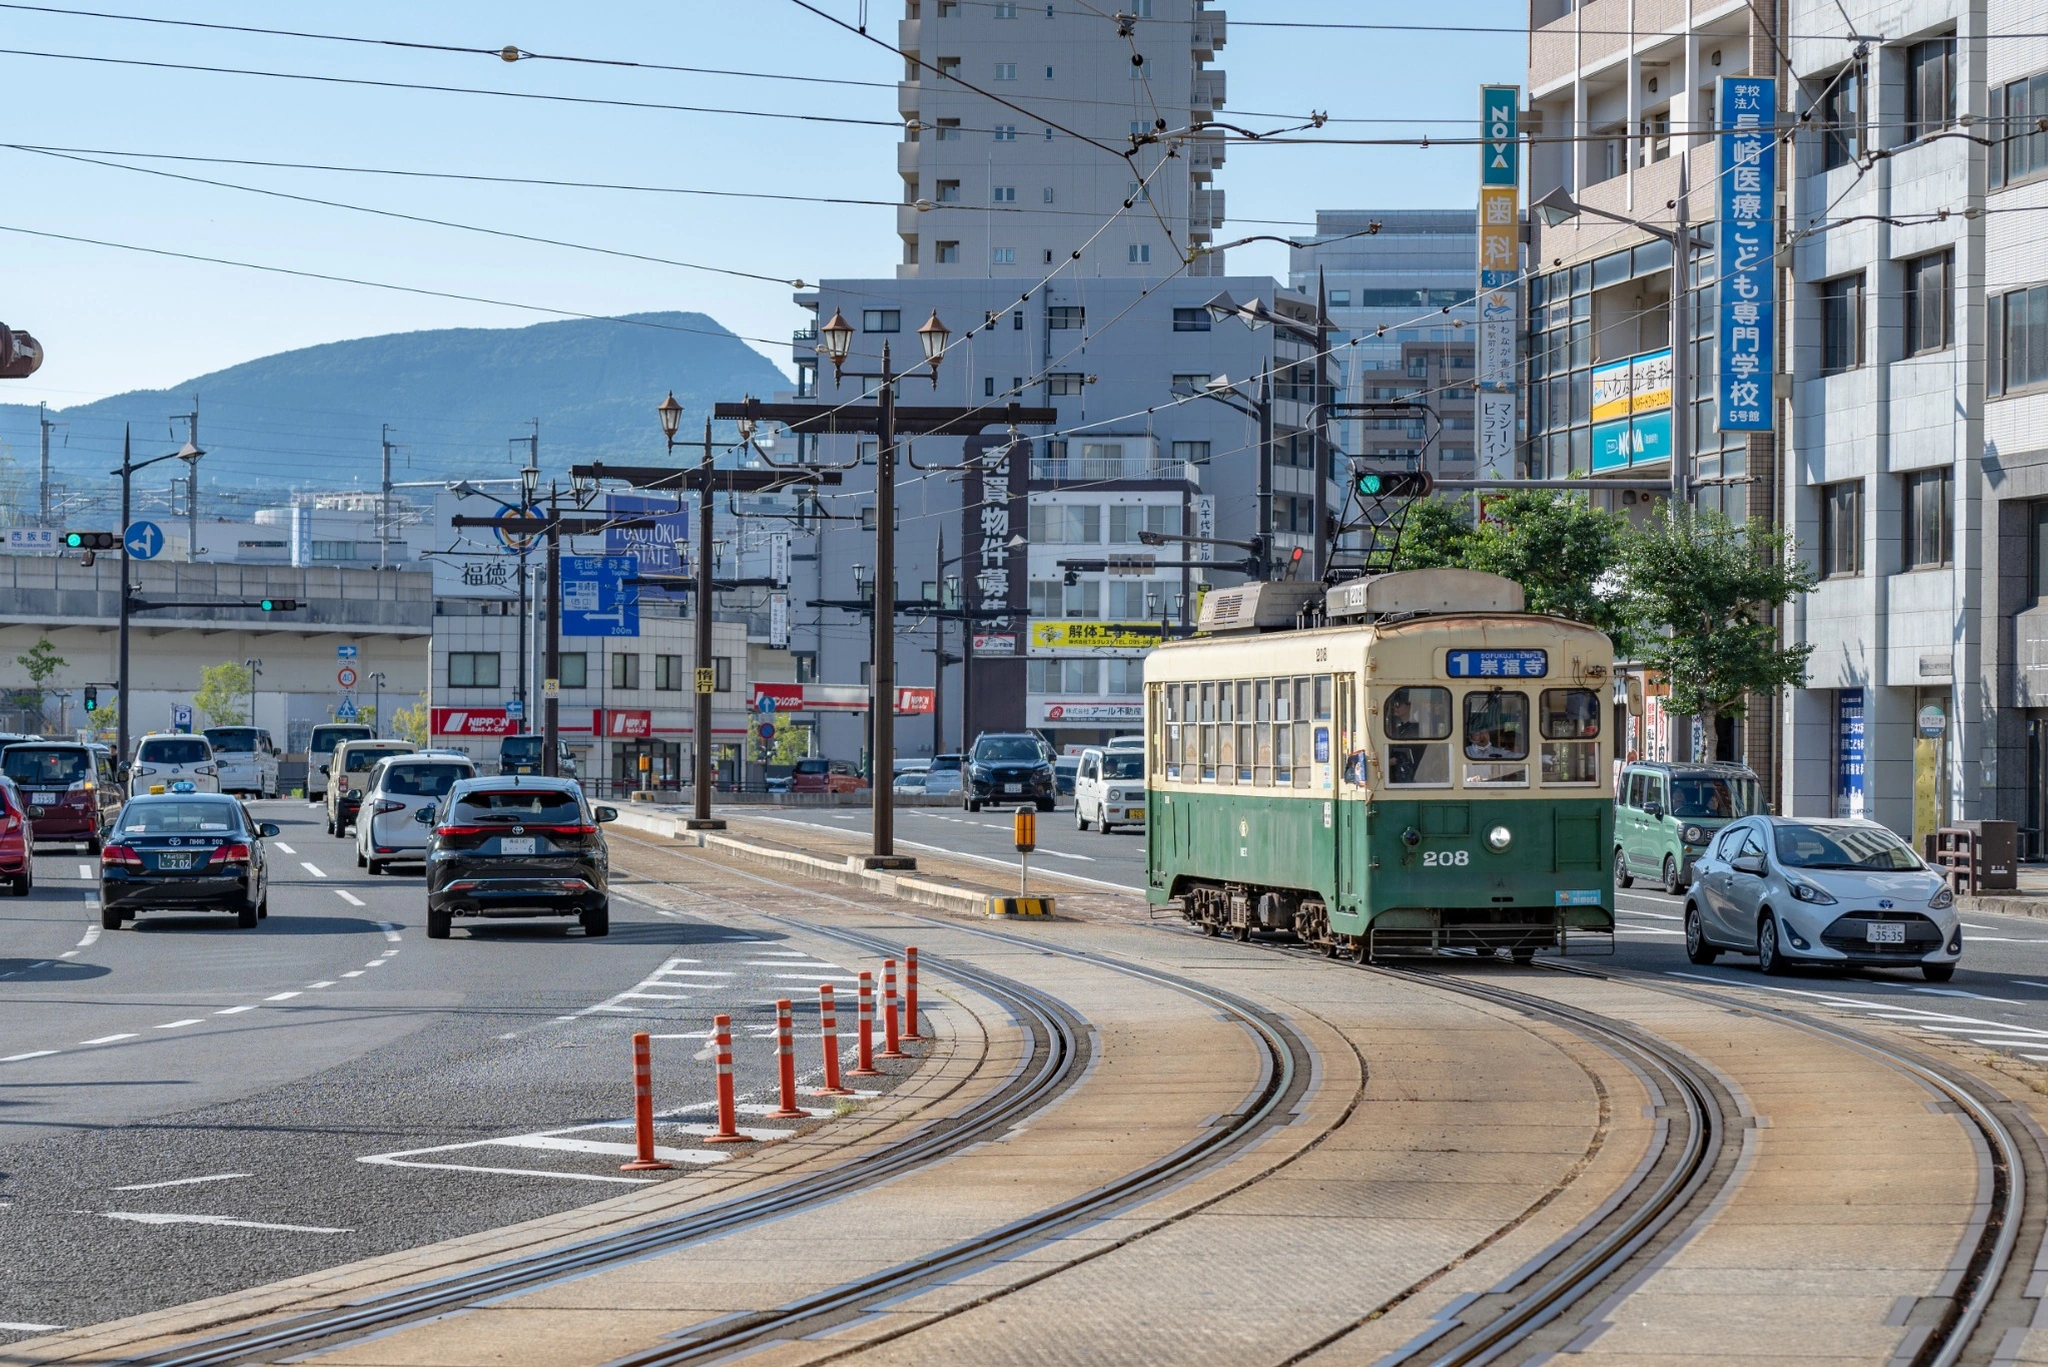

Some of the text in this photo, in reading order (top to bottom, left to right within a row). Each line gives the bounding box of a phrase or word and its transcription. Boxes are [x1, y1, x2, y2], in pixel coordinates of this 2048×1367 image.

[1735, 85, 1760, 97] 学校
[1735, 98, 1760, 110] 法人
[1491, 106, 1508, 168] NOVA
[1485, 197, 1512, 265] 歯科
[1731, 113, 1761, 407] 長崎医療こども専門学校
[1603, 360, 1673, 398] いわなが歯科
[1730, 411, 1760, 422] 5号館
[1483, 402, 1496, 467] ピラティス
[1499, 403, 1511, 457] マシーン
[12, 531, 51, 541] 西坂町
[981, 446, 1010, 628] 売買物件募集
[1201, 499, 1210, 561] 八千代町ビル
[626, 544, 669, 565] ESTATE
[574, 559, 603, 569] 佐世保
[611, 627, 632, 635] 200m
[1453, 653, 1469, 675] 1
[1480, 659, 1542, 675] 崇福寺
[342, 673, 353, 681] 40
[697, 669, 713, 692] 惰行
[1066, 706, 1142, 716] 株式会社 アール不動産
[468, 717, 510, 727] NIPPON
[625, 718, 648, 728] NIPPON
[1423, 850, 1470, 867] 208
[1876, 931, 1903, 942] 35-35
